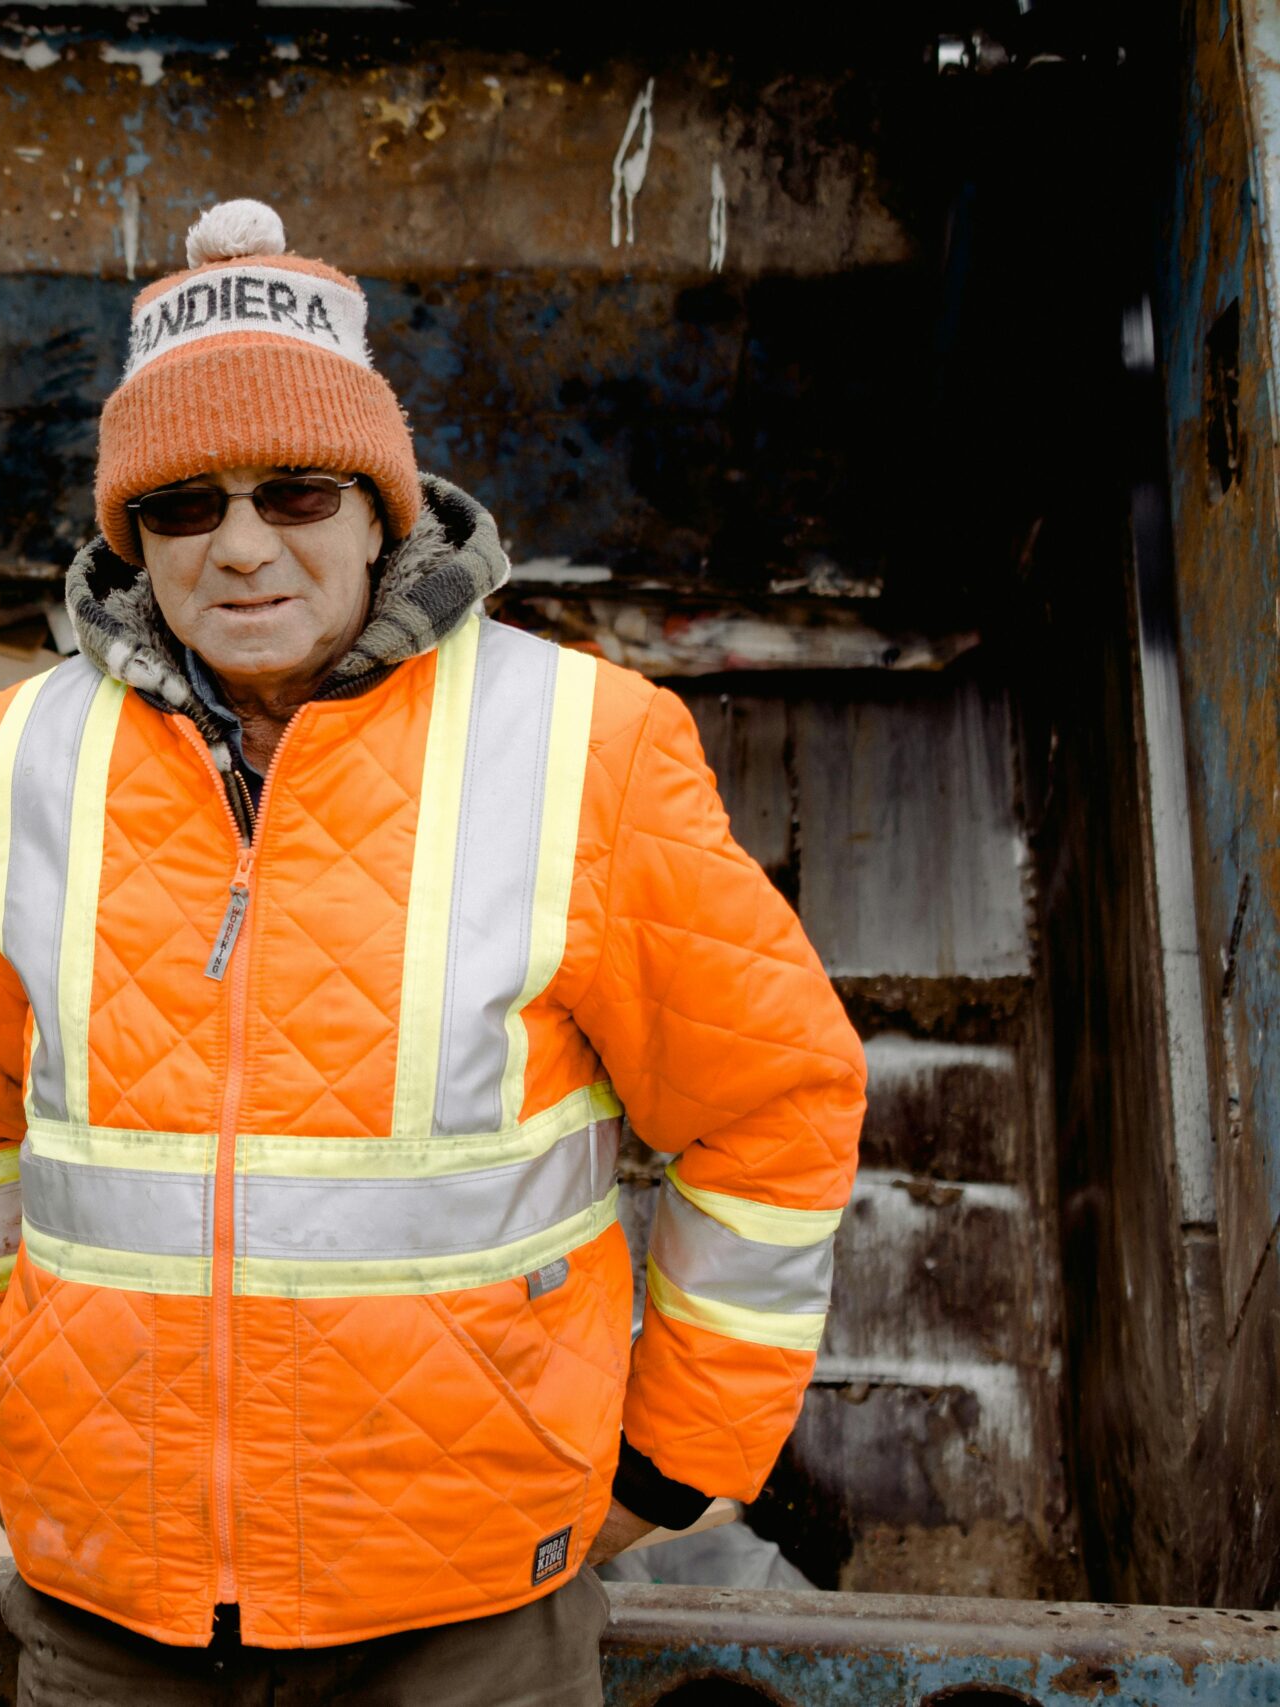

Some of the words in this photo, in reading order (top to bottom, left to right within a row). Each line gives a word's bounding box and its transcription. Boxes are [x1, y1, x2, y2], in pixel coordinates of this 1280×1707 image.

[133, 276, 340, 355] ANDIERA
[538, 1535, 567, 1558] WORK
[536, 1548, 563, 1572] KING
